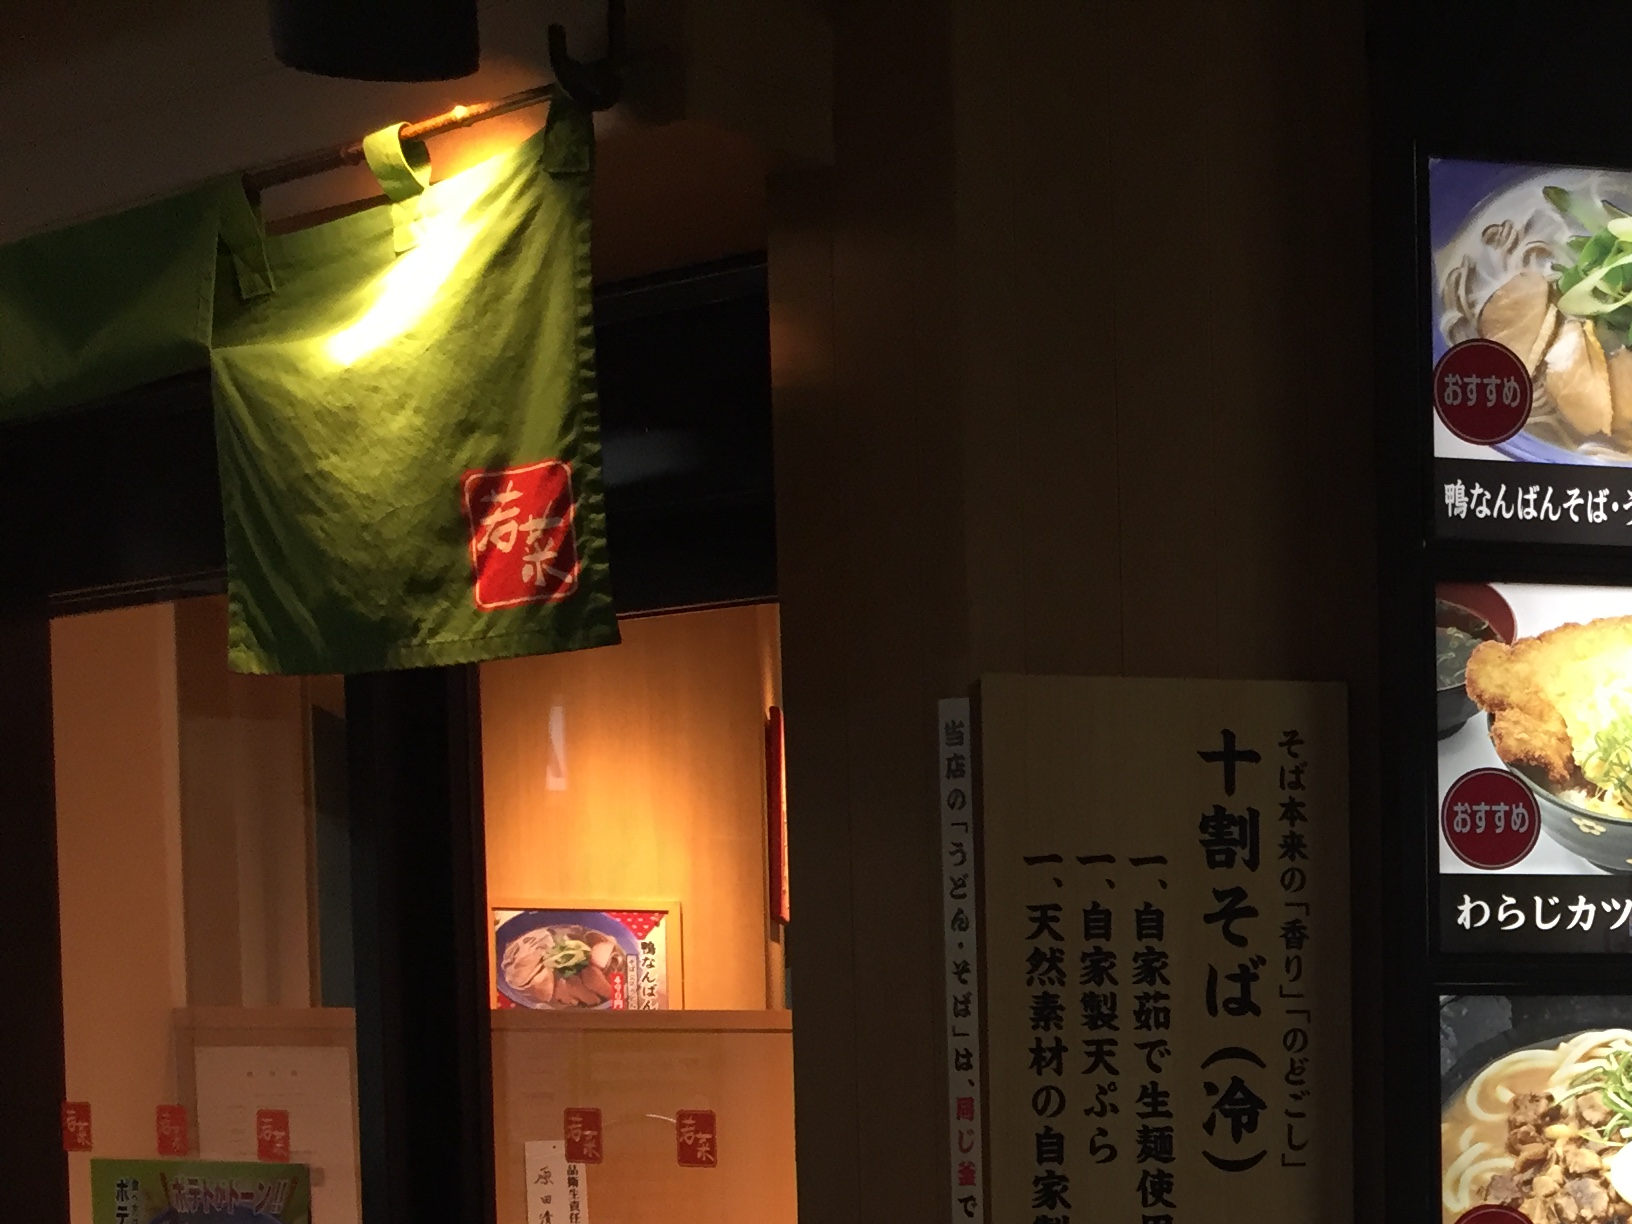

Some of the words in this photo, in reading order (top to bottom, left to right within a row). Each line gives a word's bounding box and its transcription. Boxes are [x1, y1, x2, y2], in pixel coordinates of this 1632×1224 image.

[1444, 373, 1521, 408] おすすめ
[1453, 801, 1529, 834] おすすめ
[1076, 853, 1121, 1164] 一、自家製天ぷら
[1278, 729, 1311, 1168] そば本来の「香り」「のどごし」
